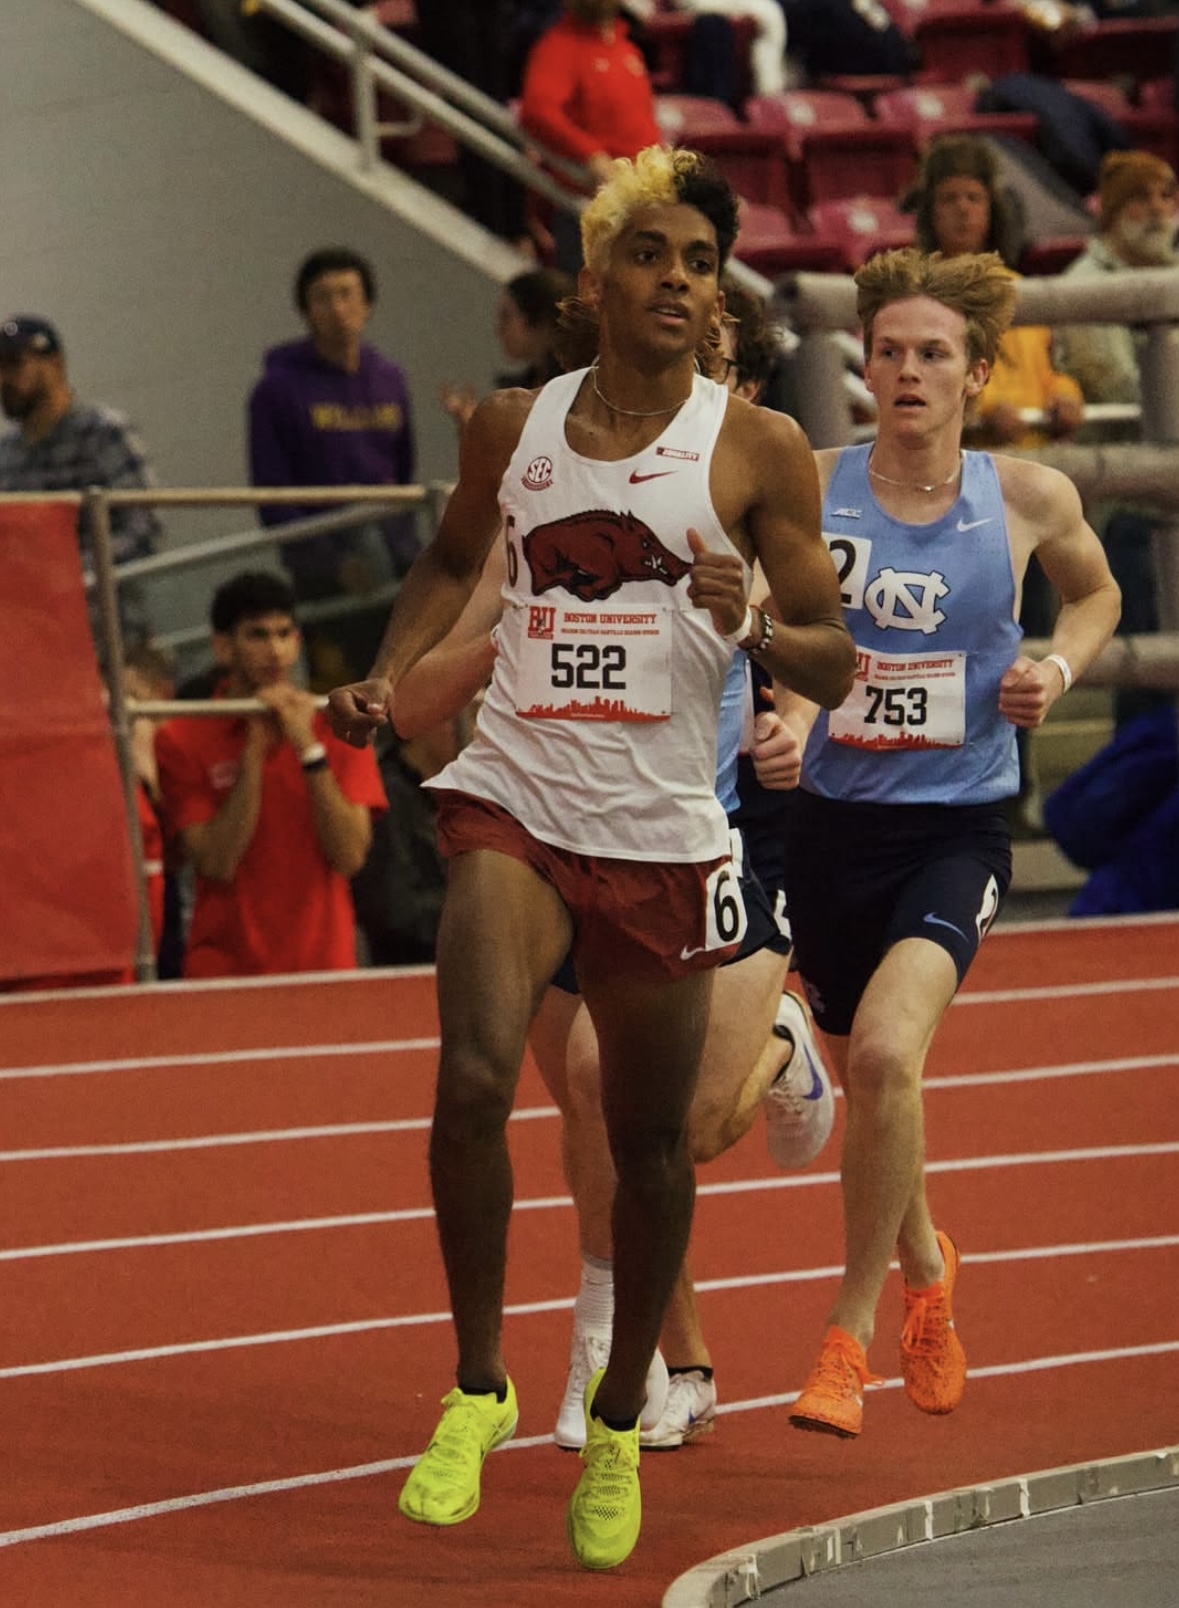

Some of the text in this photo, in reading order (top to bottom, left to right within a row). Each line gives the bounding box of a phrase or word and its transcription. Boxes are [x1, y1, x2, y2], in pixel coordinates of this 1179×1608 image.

[528, 458, 552, 483] SEC
[829, 540, 856, 604] 2
[528, 606, 556, 632] BU
[564, 612, 657, 624] BOSTON UNIVERSITY
[551, 643, 626, 689] 522
[908, 659, 954, 671] UNIVERSITY
[864, 685, 928, 726] 753
[714, 870, 739, 942] 6
